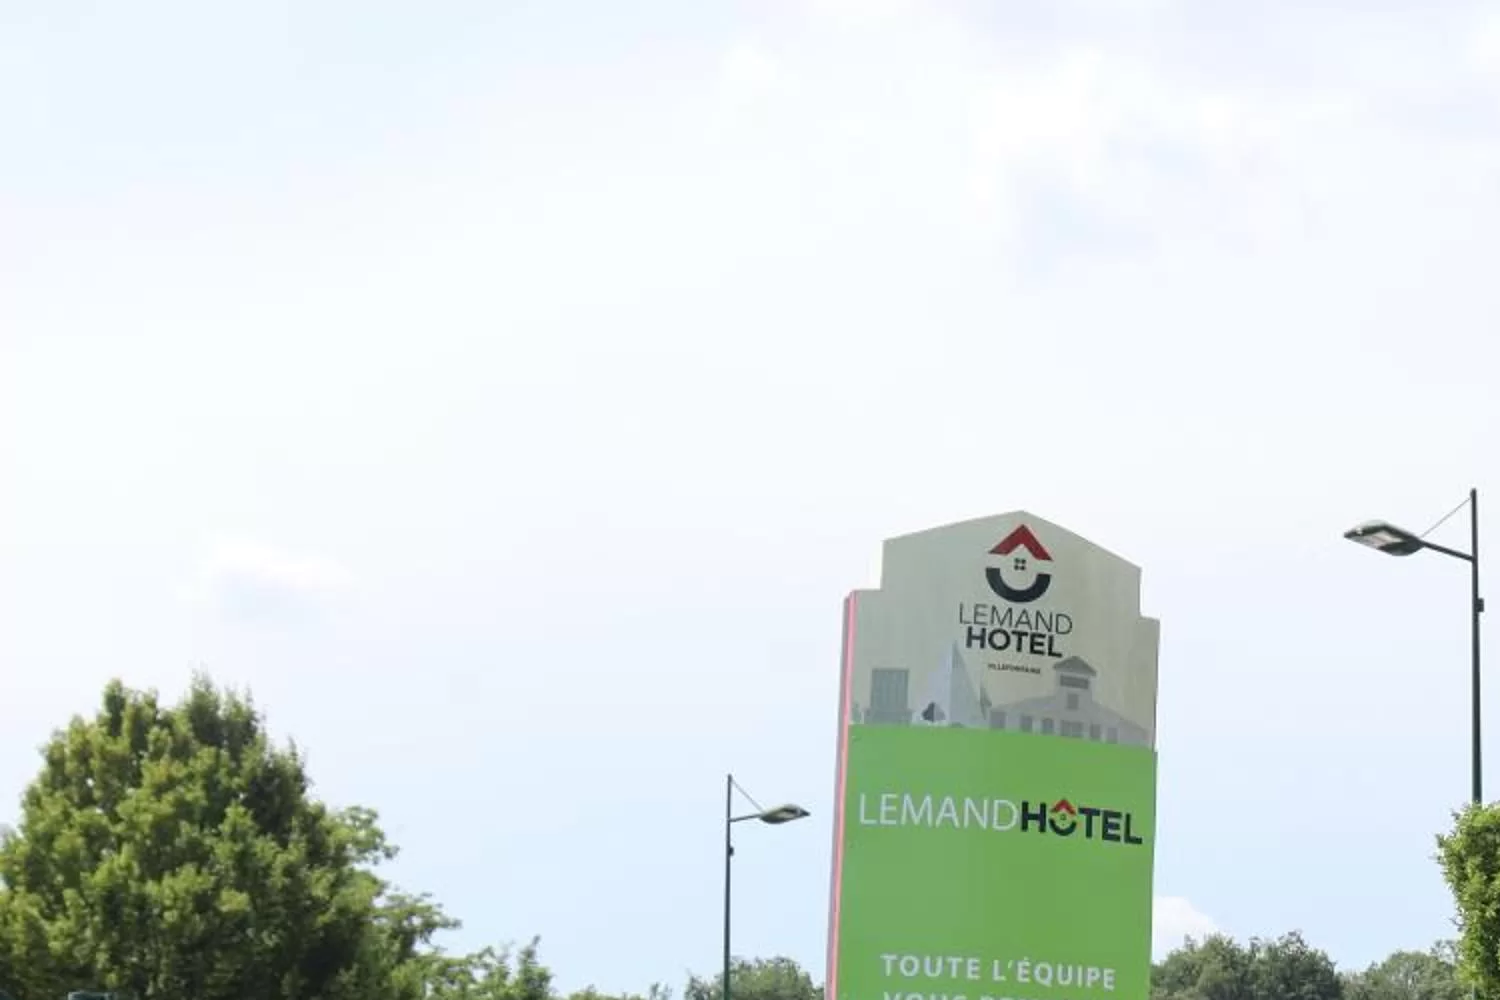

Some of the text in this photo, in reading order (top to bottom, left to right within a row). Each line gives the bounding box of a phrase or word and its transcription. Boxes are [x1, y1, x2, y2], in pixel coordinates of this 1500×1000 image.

[958, 602, 1073, 635] LEMAND
[966, 626, 1063, 658] HOTEL
[881, 954, 1116, 990] TOUTE L'ÉQUIPE
